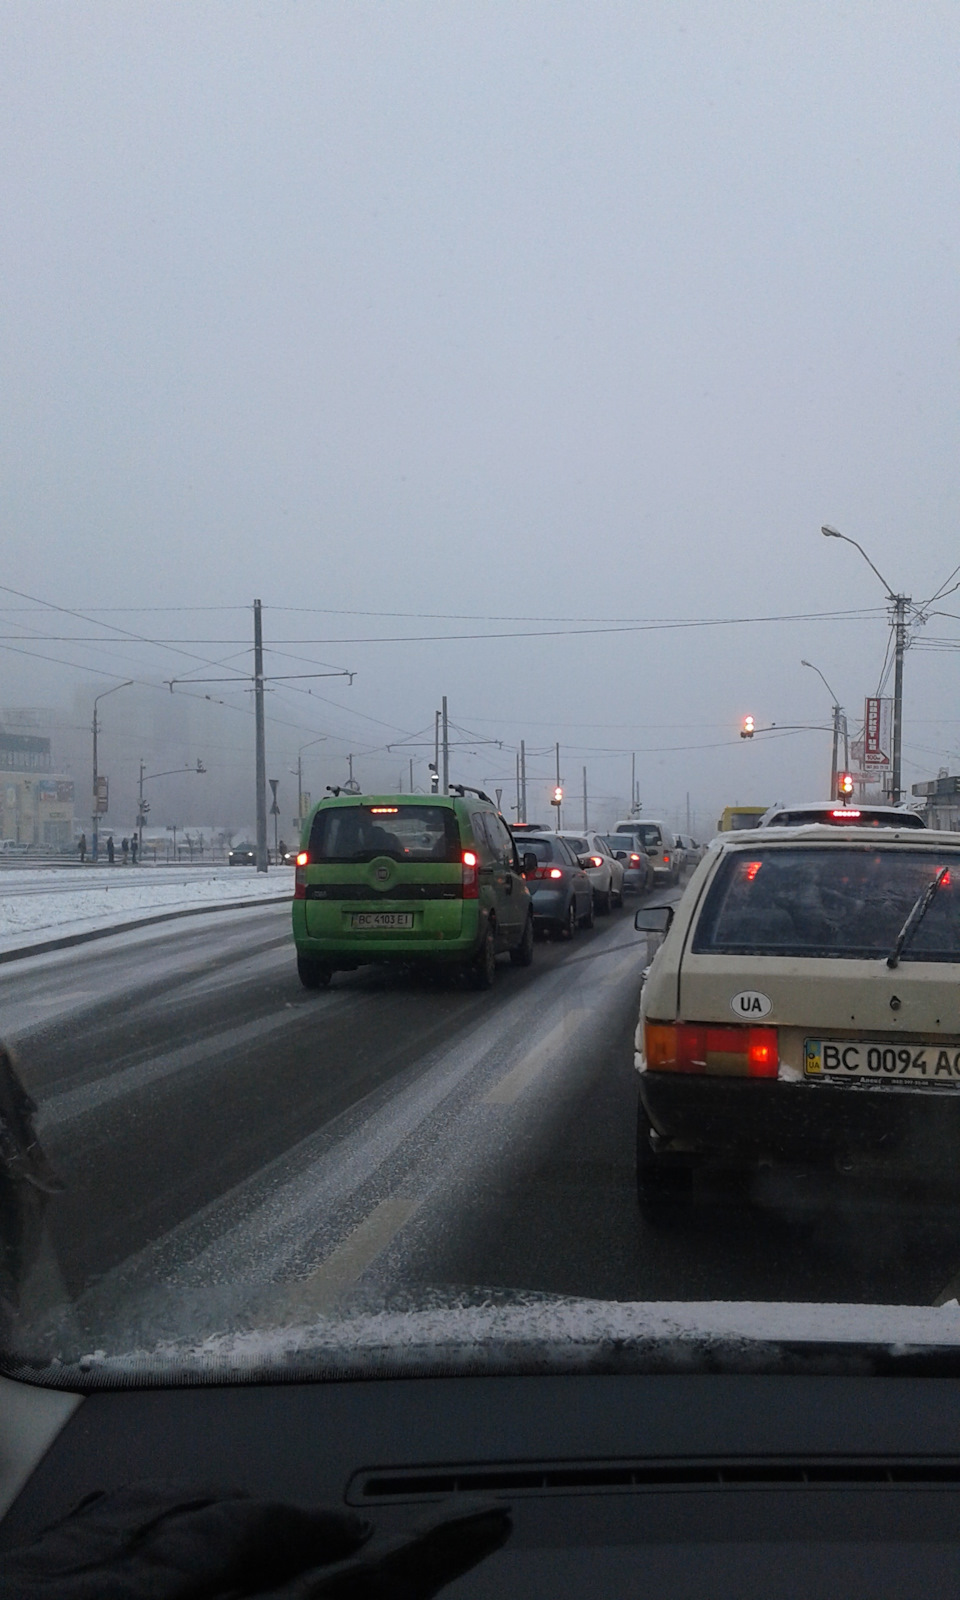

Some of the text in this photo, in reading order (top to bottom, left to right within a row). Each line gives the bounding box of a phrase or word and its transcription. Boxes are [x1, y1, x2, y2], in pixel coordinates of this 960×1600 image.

[358, 915, 372, 924] BC
[374, 914, 395, 924] 4103
[740, 996, 762, 1012] UA
[808, 1061, 820, 1069] UA
[823, 1045, 860, 1071] BC
[867, 1047, 927, 1075] 0094
